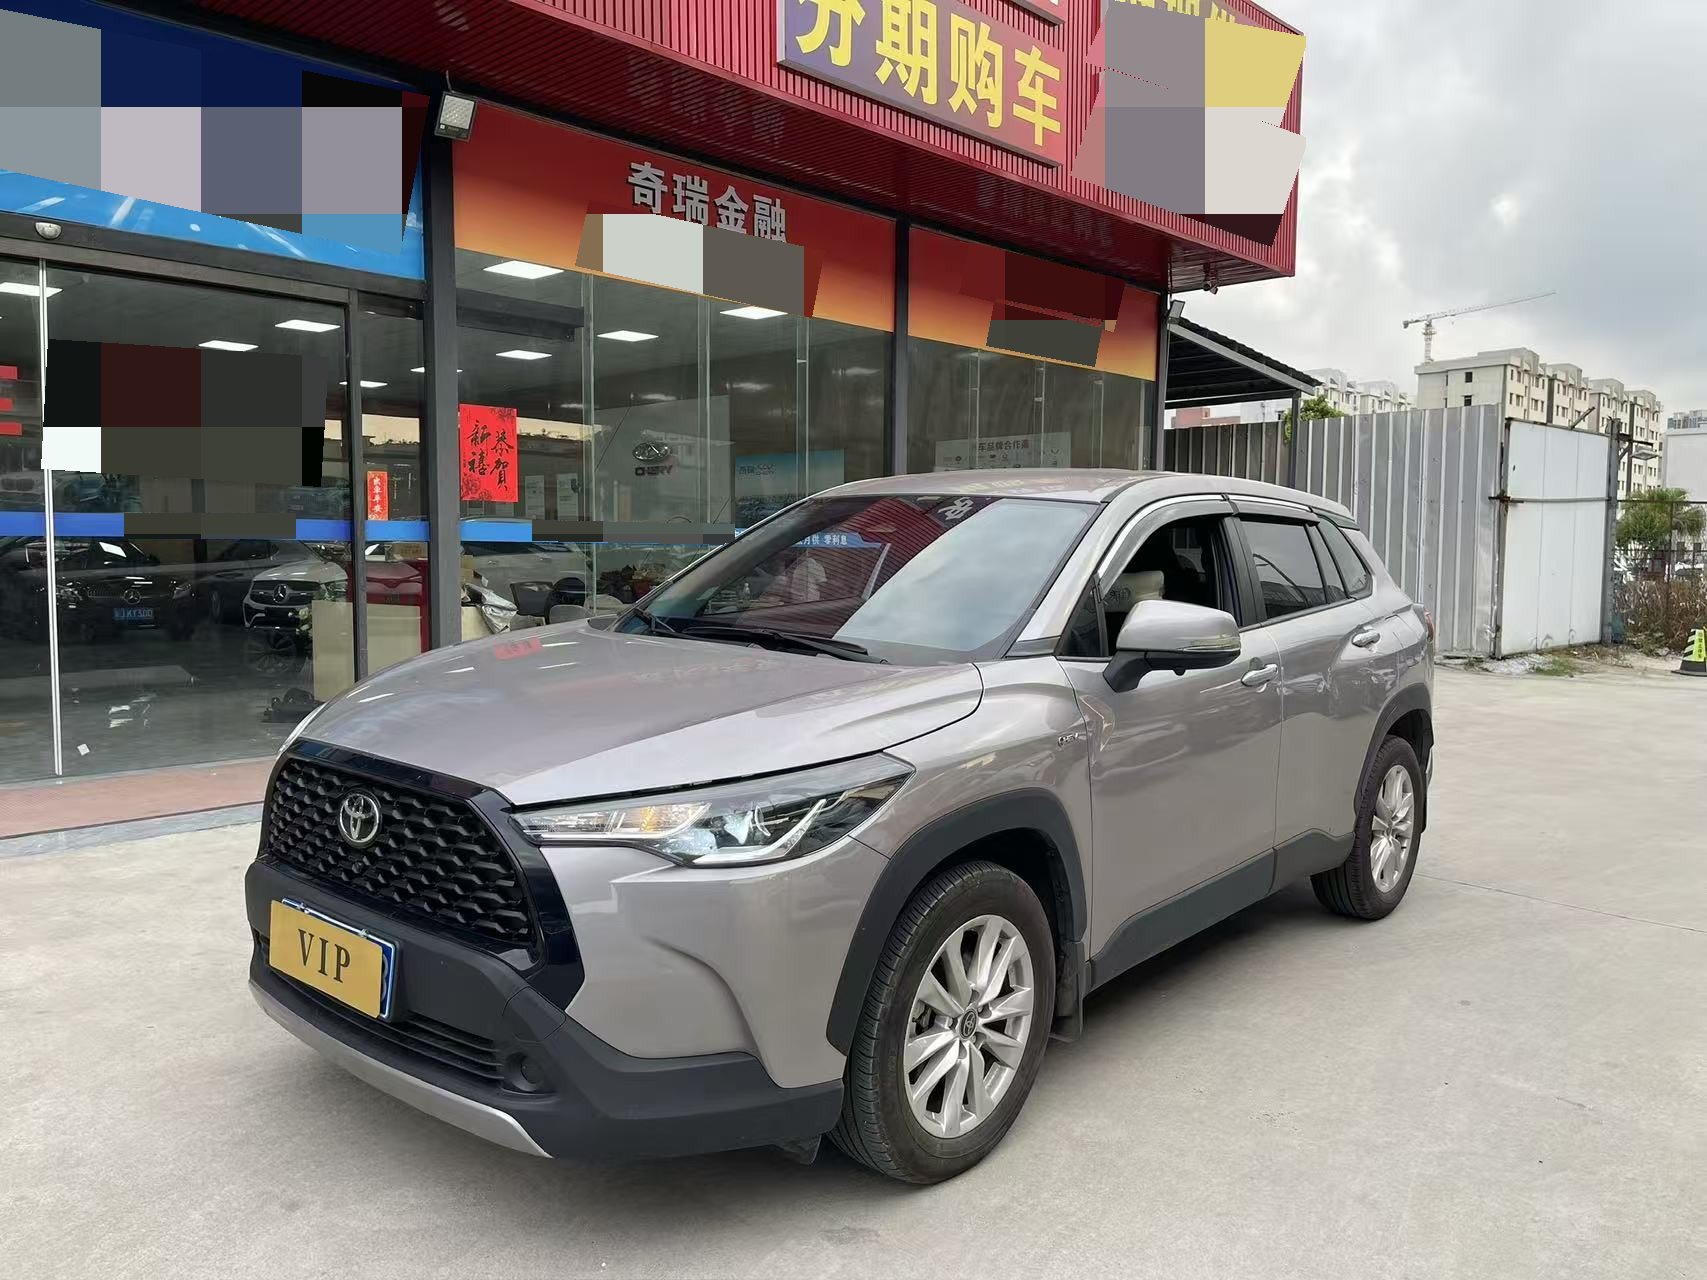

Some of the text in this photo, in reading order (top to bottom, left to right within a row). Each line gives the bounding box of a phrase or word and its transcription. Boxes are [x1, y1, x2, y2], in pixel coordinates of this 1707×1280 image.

[628, 161, 787, 243] 奇瑞金融
[298, 928, 350, 984] VIP
